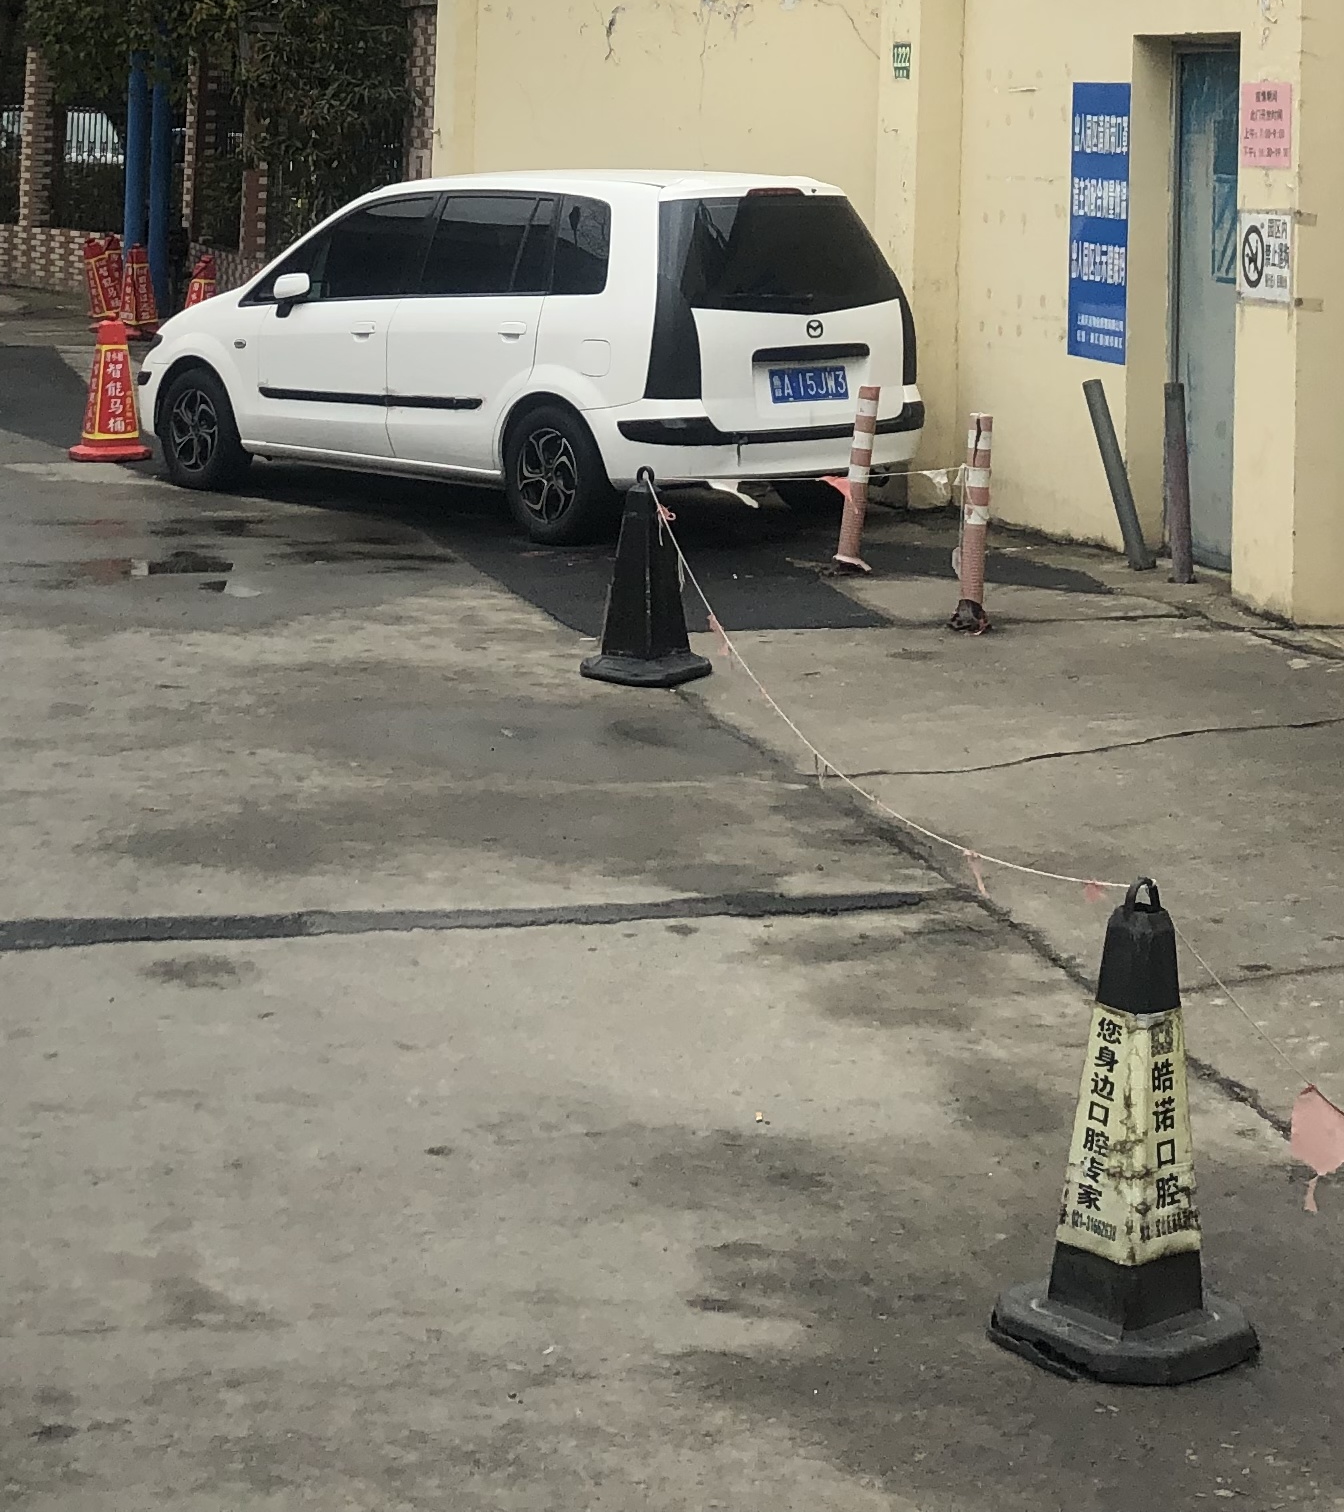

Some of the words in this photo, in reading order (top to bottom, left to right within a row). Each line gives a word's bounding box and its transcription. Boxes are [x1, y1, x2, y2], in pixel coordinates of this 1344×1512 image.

[104, 362, 125, 433] 智能马桶
[1076, 1016, 1123, 1214] 您身边口腔专家
[1151, 1059, 1181, 1210] 皓诺口腔
